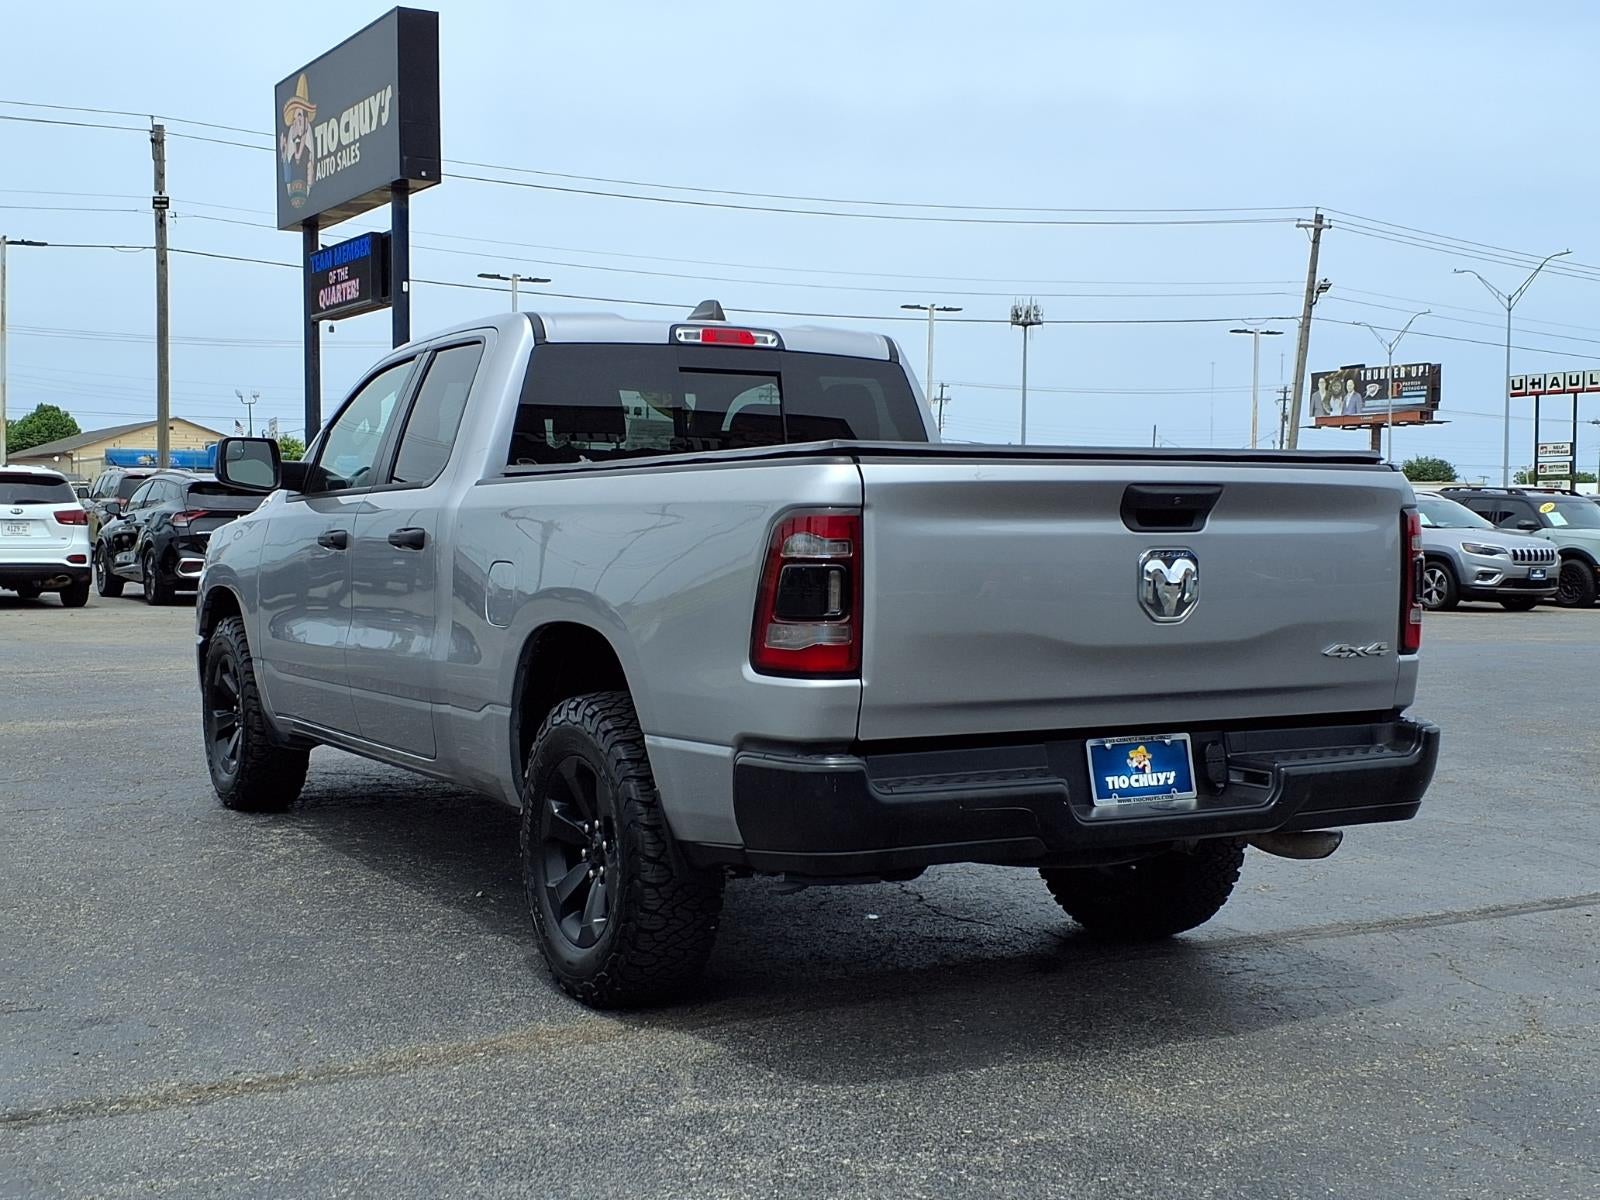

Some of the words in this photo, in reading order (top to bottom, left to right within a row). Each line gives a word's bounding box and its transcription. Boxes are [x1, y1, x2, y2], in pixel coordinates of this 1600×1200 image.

[314, 118, 338, 159] TIO
[339, 84, 392, 145] CHUY'S
[316, 161, 336, 182] AUTO
[337, 143, 361, 172] SALES
[311, 250, 332, 273] TEAM
[334, 237, 371, 265] MEMBER
[328, 270, 337, 285] OF
[337, 266, 349, 282] THE
[319, 278, 360, 310] QUARTER!
[1411, 364, 1430, 378] UP!
[1105, 775, 1130, 790] TIO
[1130, 770, 1176, 788] CHUY'S
